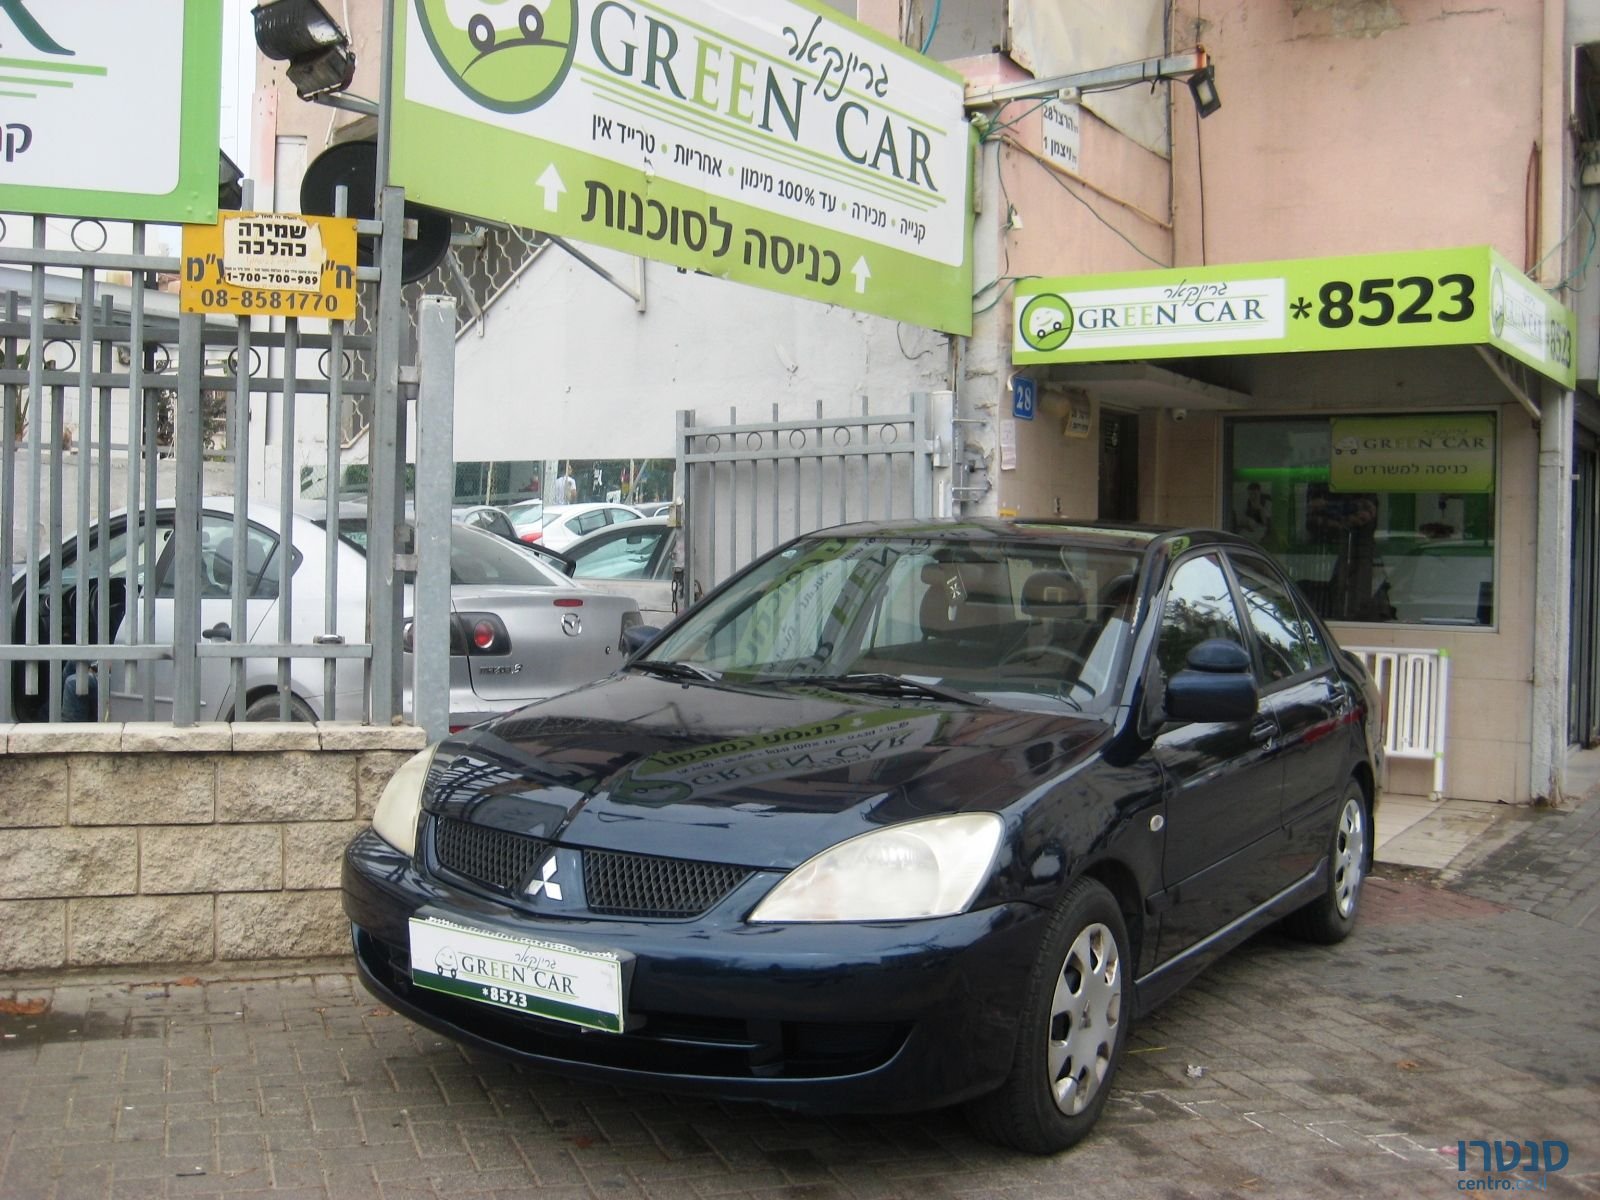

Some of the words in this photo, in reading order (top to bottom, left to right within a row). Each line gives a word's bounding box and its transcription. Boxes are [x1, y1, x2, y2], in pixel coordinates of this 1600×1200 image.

[590, 0, 807, 142] GREEN
[835, 101, 939, 192] CAR
[592, 114, 613, 141] אין
[616, 122, 656, 154] טרייד
[674, 144, 723, 177] אחריות
[740, 166, 773, 193] מימון
[777, 179, 815, 206] 100%
[819, 191, 837, 212] עד
[851, 202, 887, 228] מכירה
[238, 222, 307, 240] שמירה
[580, 180, 733, 258] לסוכנות
[900, 217, 926, 245] קנייה
[238, 239, 307, 257] כהלכה
[743, 227, 841, 287] כניסה
[226, 272, 318, 285] 1-700-700-989
[201, 288, 338, 312] 08-8581770
[1078, 303, 1178, 329] GREEN
[1195, 299, 1264, 323] CAR
[1016, 385, 1032, 411] 28
[1442, 436, 1486, 449] CAR
[1353, 462, 1420, 476] למשרדים
[1425, 463, 1468, 475] כניסה
[461, 955, 526, 984] GREEN
[534, 970, 576, 995] CAR
